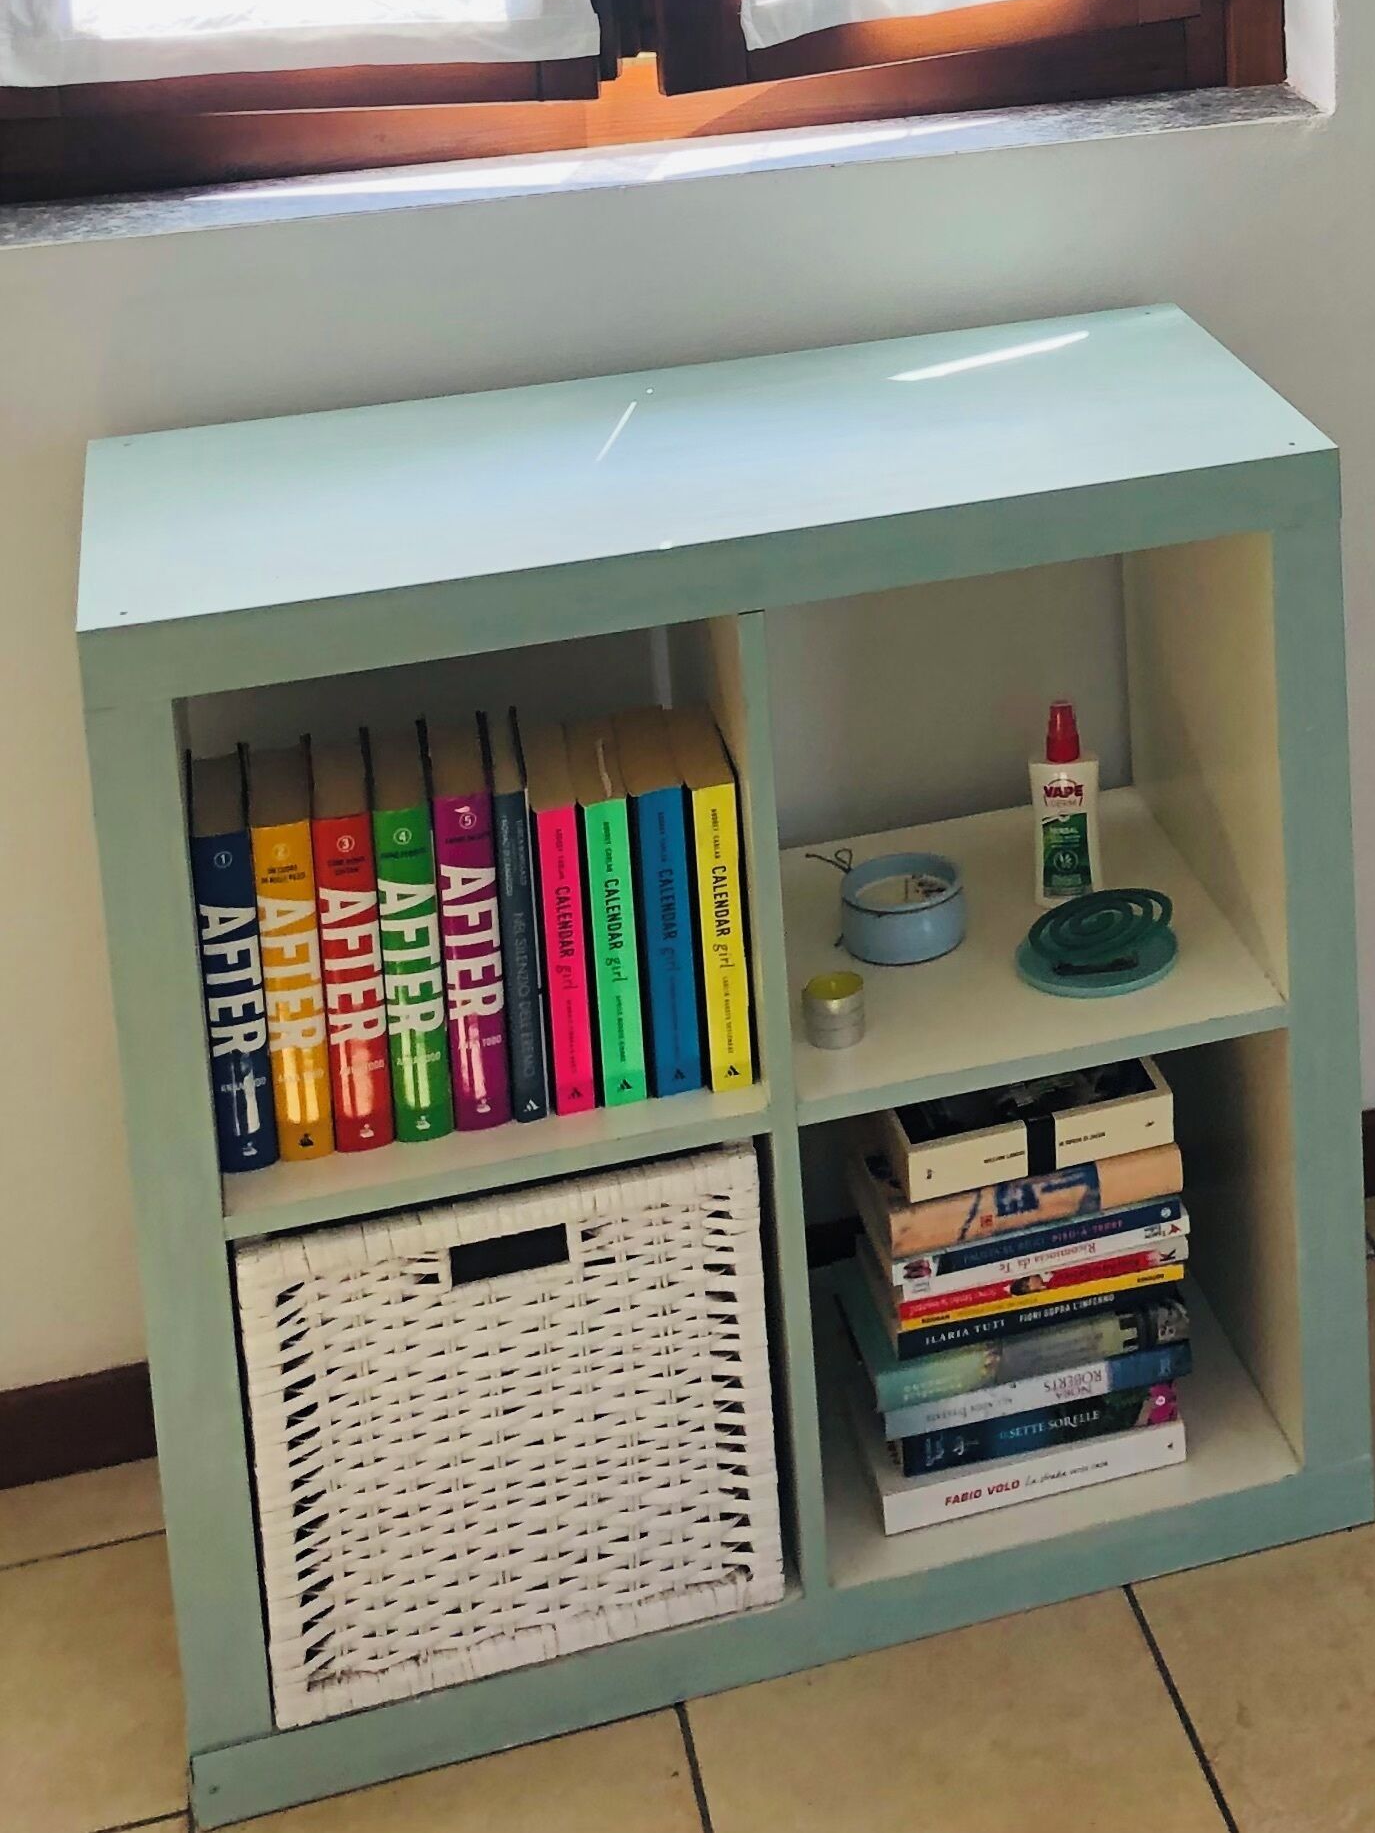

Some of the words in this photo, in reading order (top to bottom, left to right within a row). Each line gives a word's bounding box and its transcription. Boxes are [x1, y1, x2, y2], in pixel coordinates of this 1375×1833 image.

[1043, 784, 1084, 798] VAPE
[555, 886, 573, 959] CALENDAR
[604, 878, 624, 952] CALENDAR
[658, 869, 678, 942] CALENDAR
[711, 865, 732, 937] CALENDAR
[319, 888, 386, 1045] AFTER
[378, 878, 445, 1035] AFTER
[440, 864, 504, 1019] AFTER
[513, 936, 531, 998] SILENZIO
[660, 947, 681, 974] girl
[713, 943, 734, 969] girl
[198, 904, 266, 1057] AFTER
[257, 896, 324, 1051] AFTER
[558, 963, 578, 991] girl
[606, 957, 629, 984] girl
[1016, 1256, 1030, 1270] da
[924, 1327, 970, 1346] ILARIA
[973, 1318, 1006, 1335] TUTI
[1019, 1310, 1041, 1324] FIORI
[1043, 1305, 1071, 1319] SOPRA
[1044, 1368, 1104, 1394] ROBERTS
[1008, 1422, 1046, 1439] SETTE
[1047, 1410, 1101, 1429] SORELLE
[944, 1488, 983, 1507] FABIO
[986, 1479, 1021, 1497] VOLO
